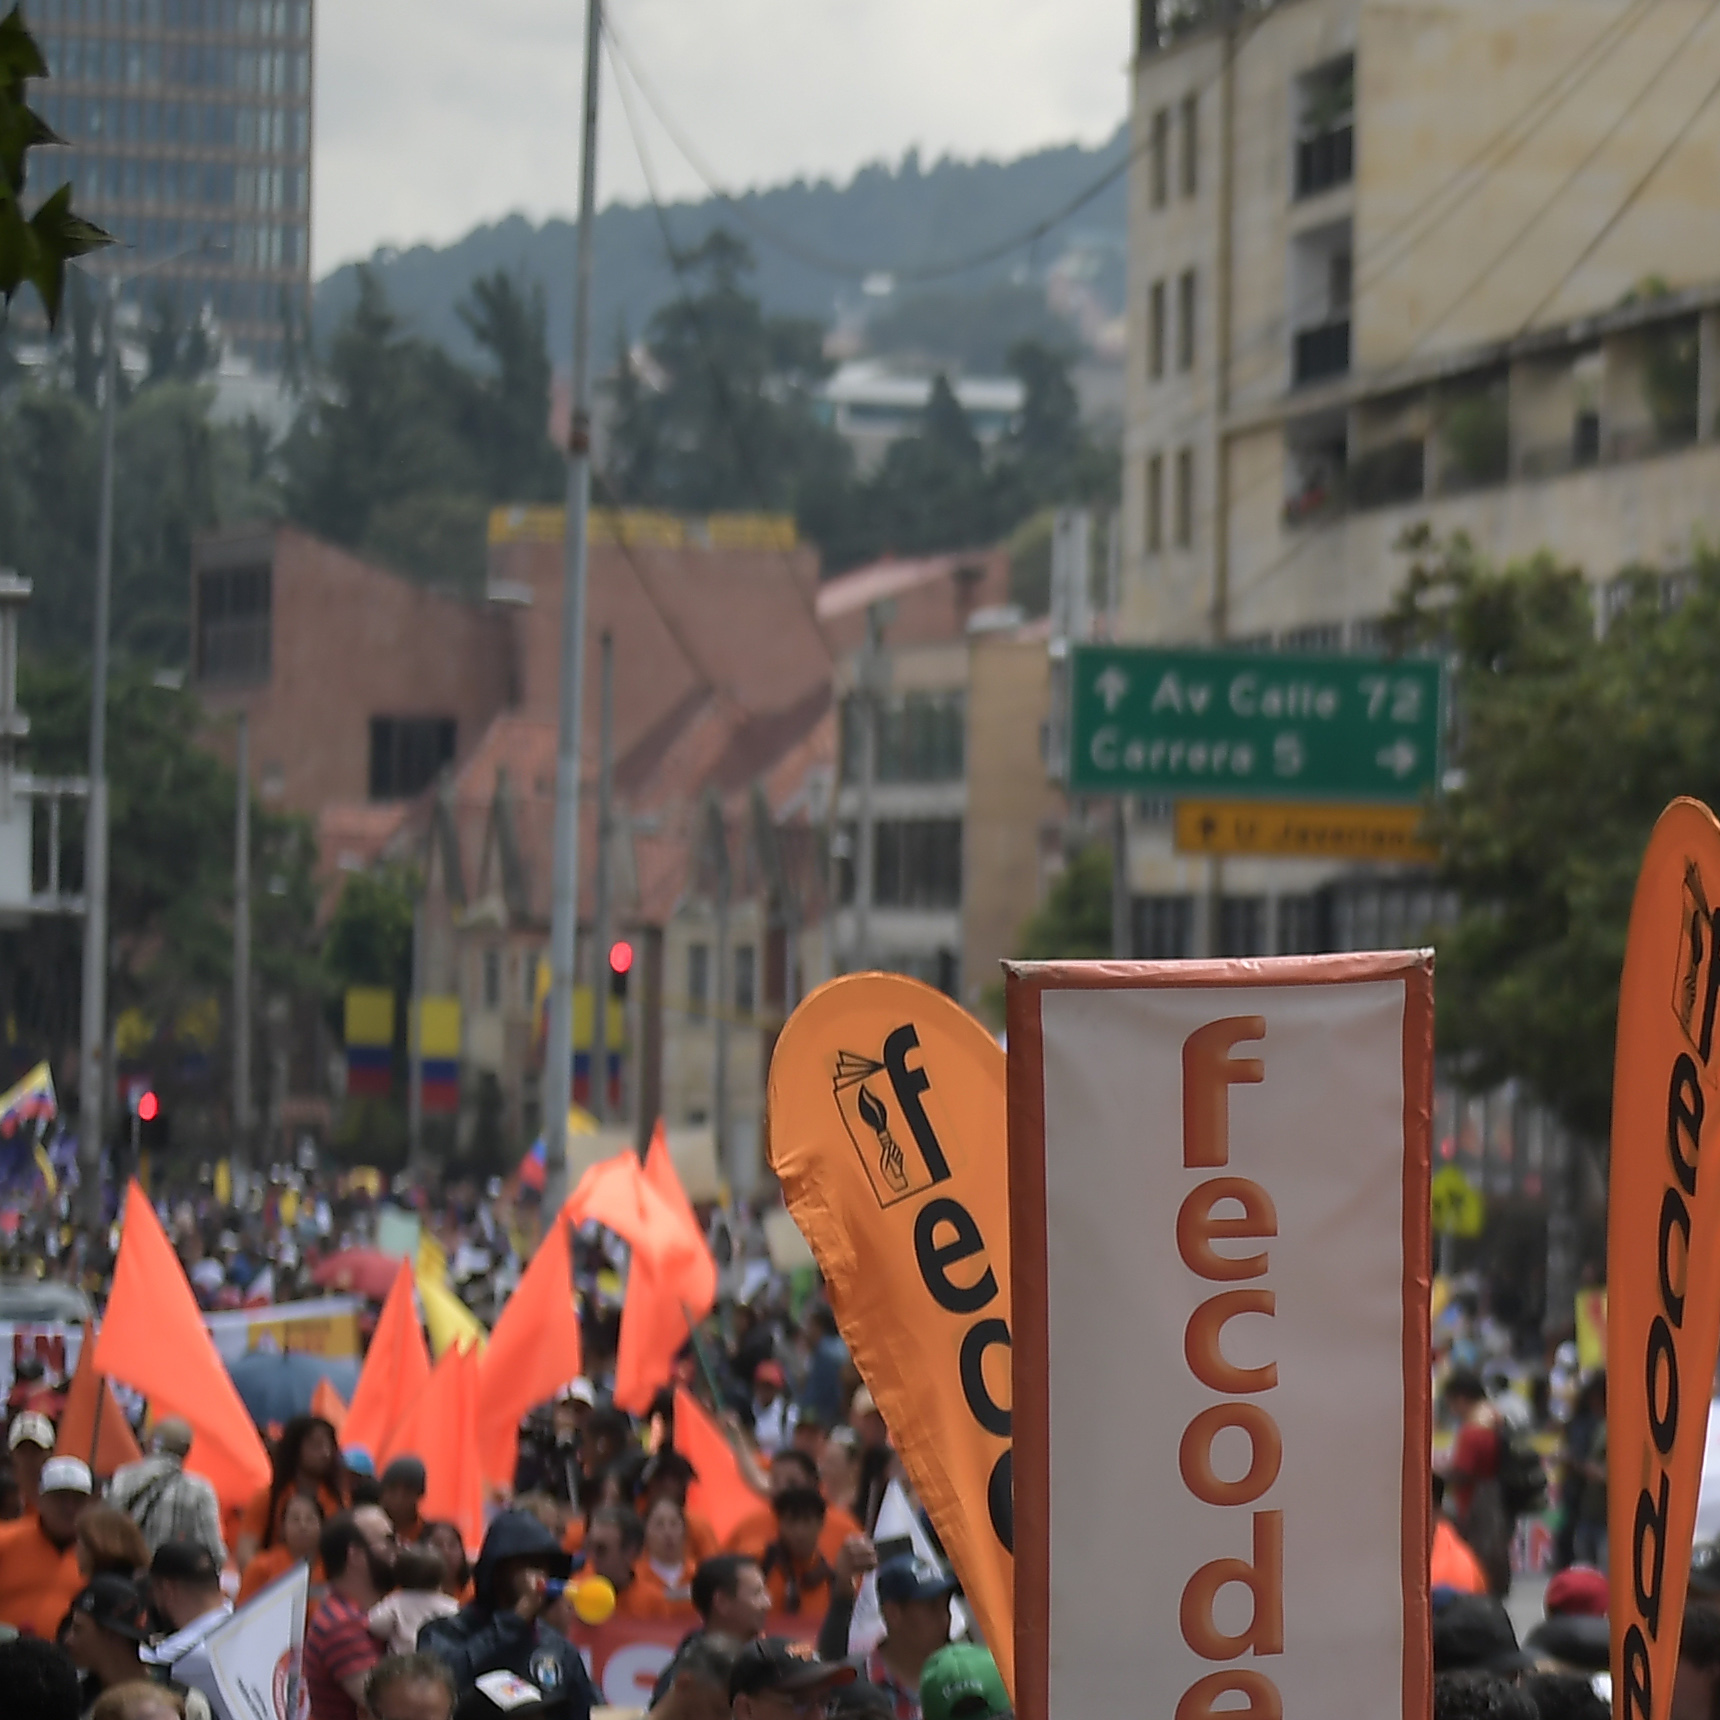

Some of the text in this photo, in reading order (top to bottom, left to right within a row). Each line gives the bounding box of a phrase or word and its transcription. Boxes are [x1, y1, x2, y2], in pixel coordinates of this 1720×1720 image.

[1151, 669, 1421, 722] Av Calle 72
[1090, 725, 1251, 776] Carrera
[883, 1023, 1014, 1555] fec
